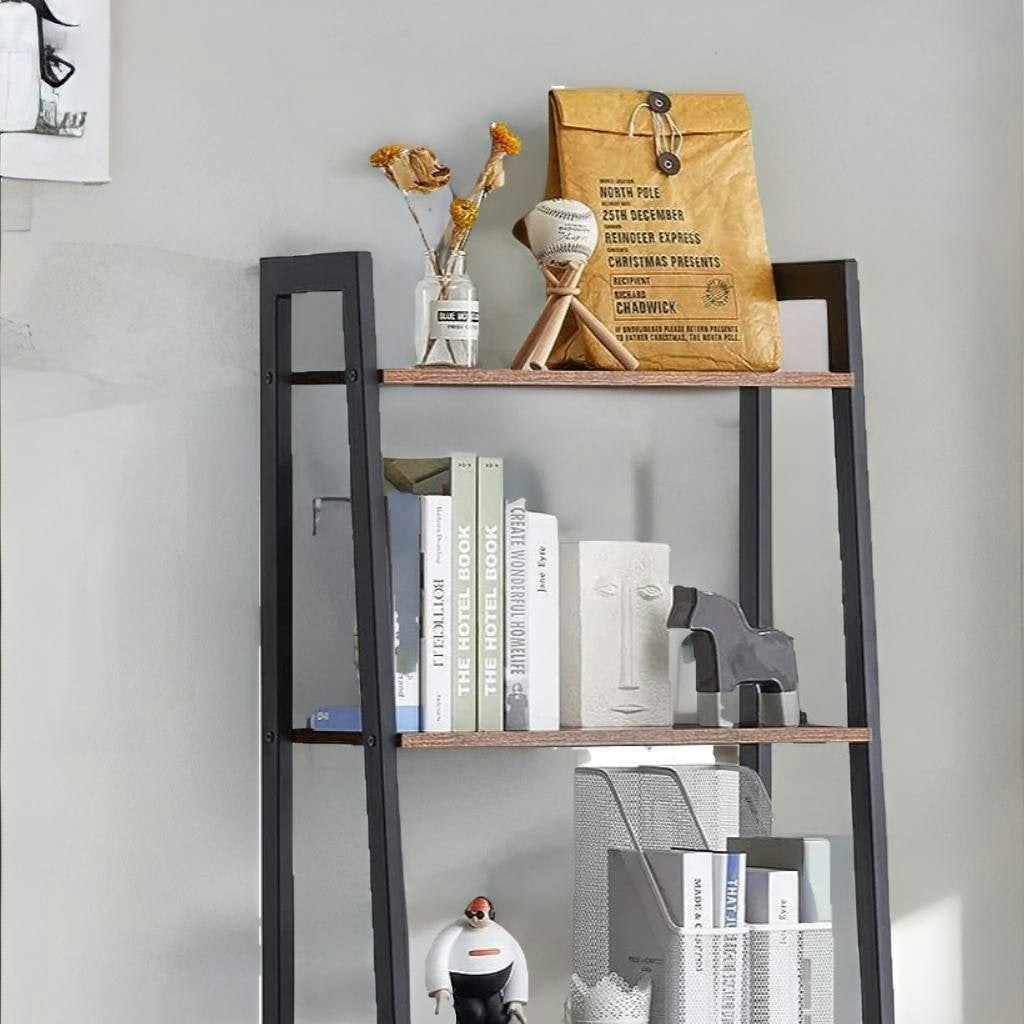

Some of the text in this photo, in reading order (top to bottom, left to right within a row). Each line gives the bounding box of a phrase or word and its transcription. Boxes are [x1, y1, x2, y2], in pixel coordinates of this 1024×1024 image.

[600, 186, 661, 199] NORTH POLE
[602, 209, 685, 222] 25TH DECEMBER
[605, 231, 702, 245] REINDEER EXPRESS
[608, 255, 721, 269] CHRISTMAS PRESENTS
[613, 277, 651, 286] RECIPIENT
[616, 301, 678, 314] CHADWICK
[537, 546, 548, 593] Jane Eyre
[510, 506, 526, 675] CREATE WONDERFUL HOMELIFE
[432, 579, 445, 667] BOTTICELLI
[457, 525, 471, 696] THE HOTEL BOOK
[484, 525, 498, 696] THE HOTEL BOOK
[694, 878, 703, 910] MADE
[726, 878, 738, 913] THAT
